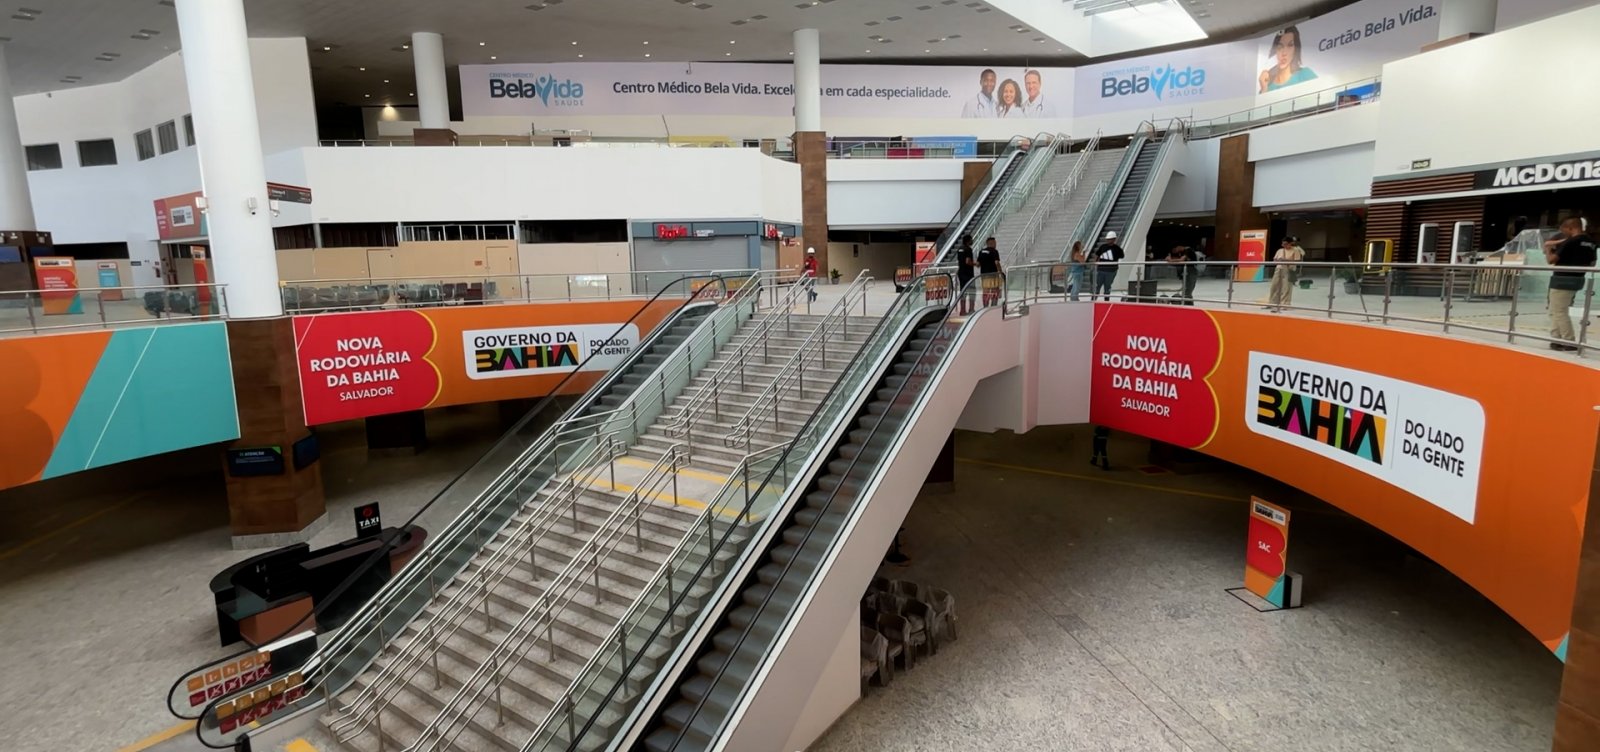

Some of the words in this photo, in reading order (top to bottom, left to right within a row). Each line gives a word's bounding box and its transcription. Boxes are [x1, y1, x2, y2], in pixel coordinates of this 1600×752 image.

[1318, 29, 1361, 52] Cartão
[1364, 17, 1395, 37] Bela
[1399, 5, 1437, 26] Vida.
[613, 81, 655, 94] Centro
[657, 80, 701, 94] Médico
[704, 83, 730, 94] Bela
[732, 83, 761, 95] Vida.
[826, 87, 844, 97] em
[849, 86, 873, 97] cada
[875, 86, 951, 100] especialidade.
[336, 336, 383, 352] NOVA
[474, 332, 552, 348] GOVERNO
[556, 331, 577, 343] DA
[1126, 335, 1168, 354] NOVA
[310, 349, 412, 372] RODOVIÁRIA
[475, 344, 579, 373] BAHIA
[1101, 352, 1192, 380] RODOVIÁRIA
[326, 373, 350, 388] DA
[352, 368, 400, 384] BAHIA
[1112, 373, 1132, 390] DA
[1135, 377, 1178, 400] BAHIA
[1260, 364, 1353, 404] GOVERNO
[1359, 385, 1387, 415] DA
[339, 386, 394, 402] SALVADOR
[1121, 397, 1170, 417] SALVADOR
[1257, 385, 1386, 466] BAHIA
[1404, 419, 1425, 439] DO
[1428, 426, 1464, 453] LADO
[1403, 438, 1420, 459] DA
[1423, 447, 1465, 478] GENTE
[1258, 541, 1271, 553] SAC
